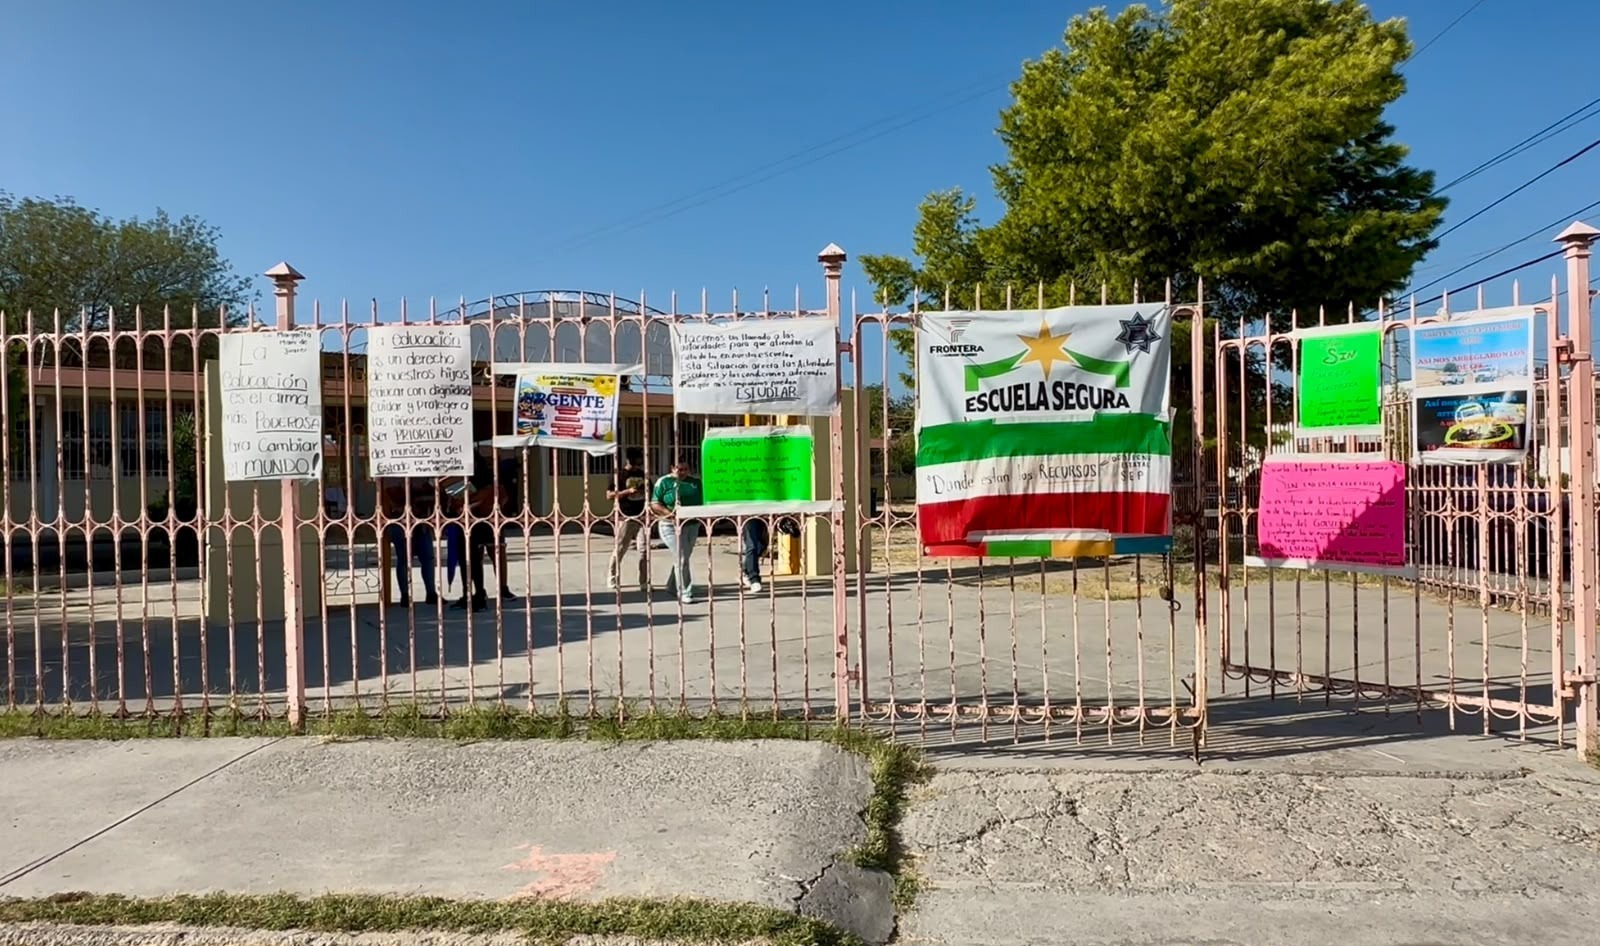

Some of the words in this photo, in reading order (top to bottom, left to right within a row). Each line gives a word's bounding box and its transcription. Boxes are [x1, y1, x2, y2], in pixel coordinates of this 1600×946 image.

[741, 333, 771, 341] llamado
[782, 330, 795, 339] las
[240, 335, 268, 366] La
[729, 341, 749, 350] para
[805, 338, 814, 346] la
[929, 344, 985, 354] FRONTERA
[388, 354, 403, 365] un
[406, 351, 455, 366] derecho
[1322, 347, 1357, 365] SIN
[386, 368, 436, 381] nuestros
[440, 366, 470, 382] hijos
[230, 392, 246, 405] es
[249, 391, 263, 405] el
[406, 387, 426, 397] con
[429, 384, 472, 399] dignidad
[736, 386, 797, 401] ESTUDIAR
[965, 382, 1051, 412] ESCUELA
[1052, 380, 1131, 410] SEGURA
[407, 401, 415, 414] y
[416, 399, 458, 414] proteger
[460, 402, 469, 411] a
[432, 413, 464, 425] debe
[393, 428, 454, 442] PRIORIDAD
[258, 437, 319, 453] Cambiar
[433, 447, 441, 457] y
[444, 445, 463, 456] del
[1039, 463, 1097, 480] RECURSOS
[1121, 470, 1144, 481] SEP
